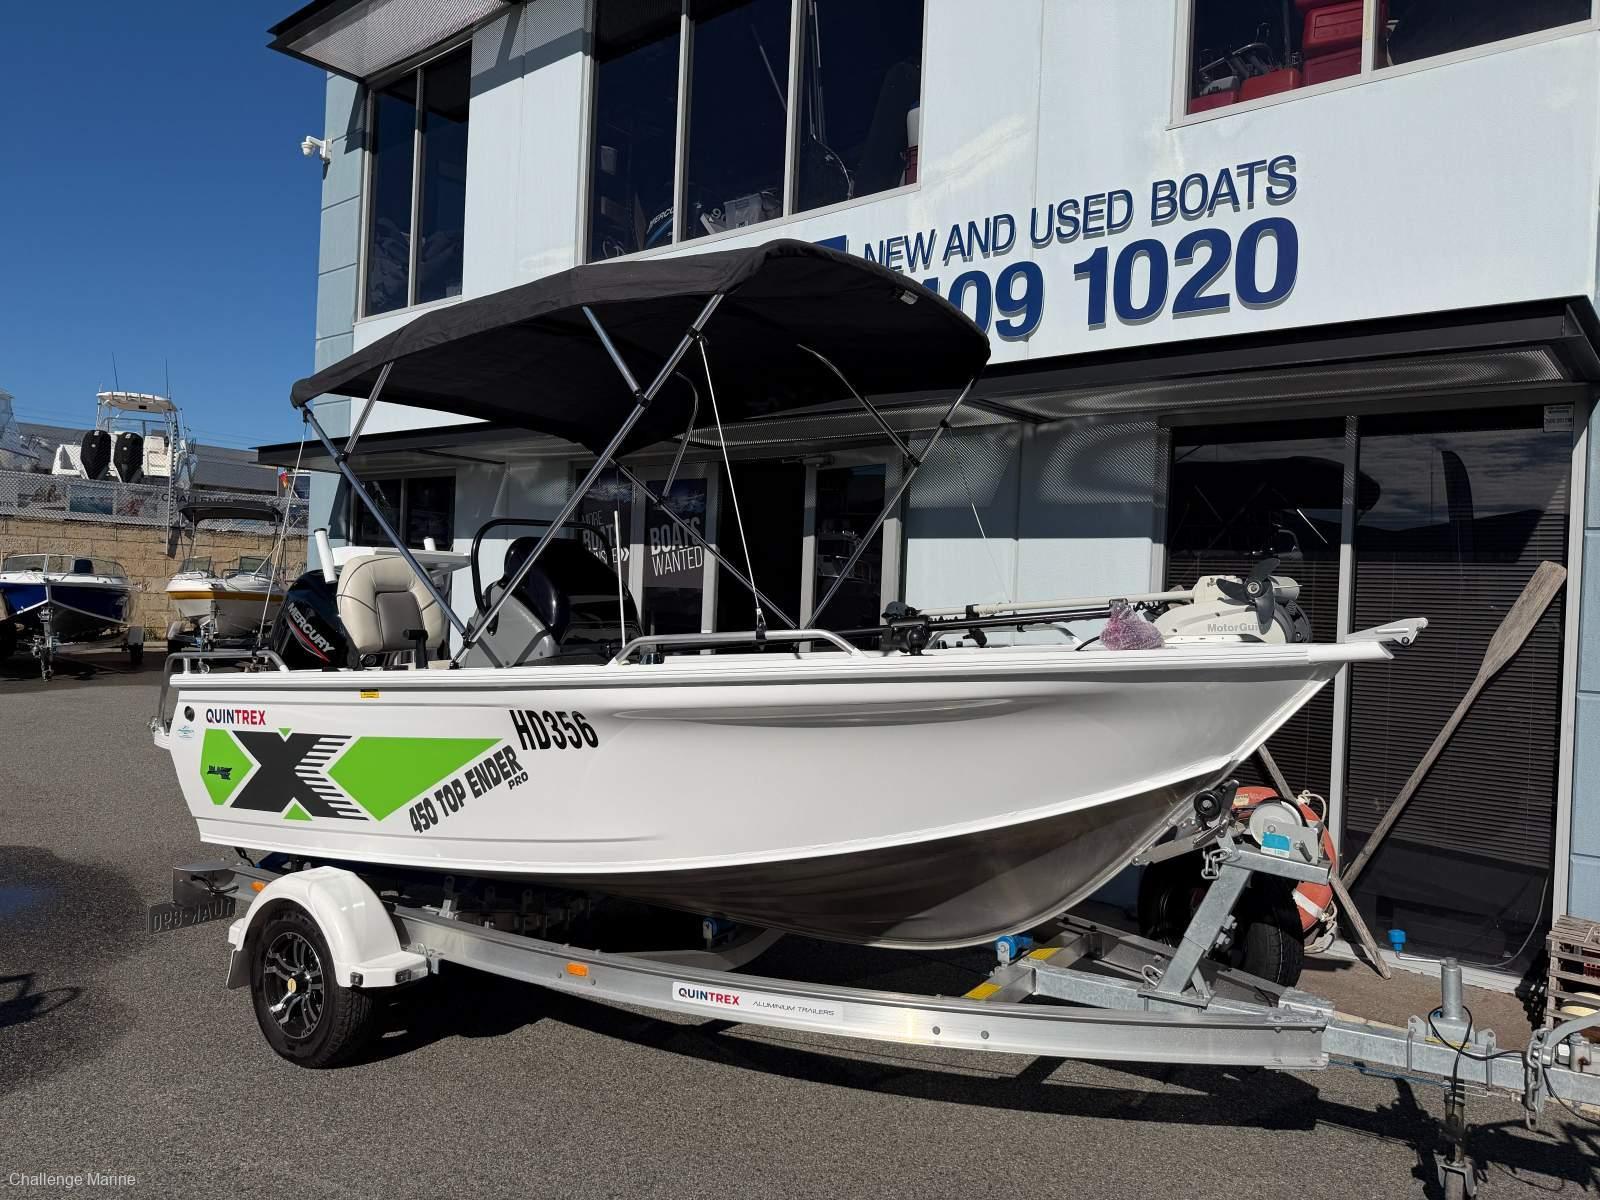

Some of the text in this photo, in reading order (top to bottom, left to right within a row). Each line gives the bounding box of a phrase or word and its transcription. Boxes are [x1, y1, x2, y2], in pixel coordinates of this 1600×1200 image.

[943, 213, 1016, 263] AND
[1029, 188, 1133, 248] USED
[1151, 154, 1298, 227] BOATS
[921, 216, 1299, 342] 09 1020
[651, 546, 704, 577] WANTED
[287, 601, 336, 653] MERCURY
[1207, 623, 1259, 633] MotorGui
[205, 708, 266, 726] QUINTREX
[509, 709, 599, 751] HD356
[408, 744, 524, 834] 450 TOP ENDER
[507, 771, 529, 791] PRO
[678, 987, 741, 1006] QUINTREX
[797, 1006, 835, 1017] TRAILERS
